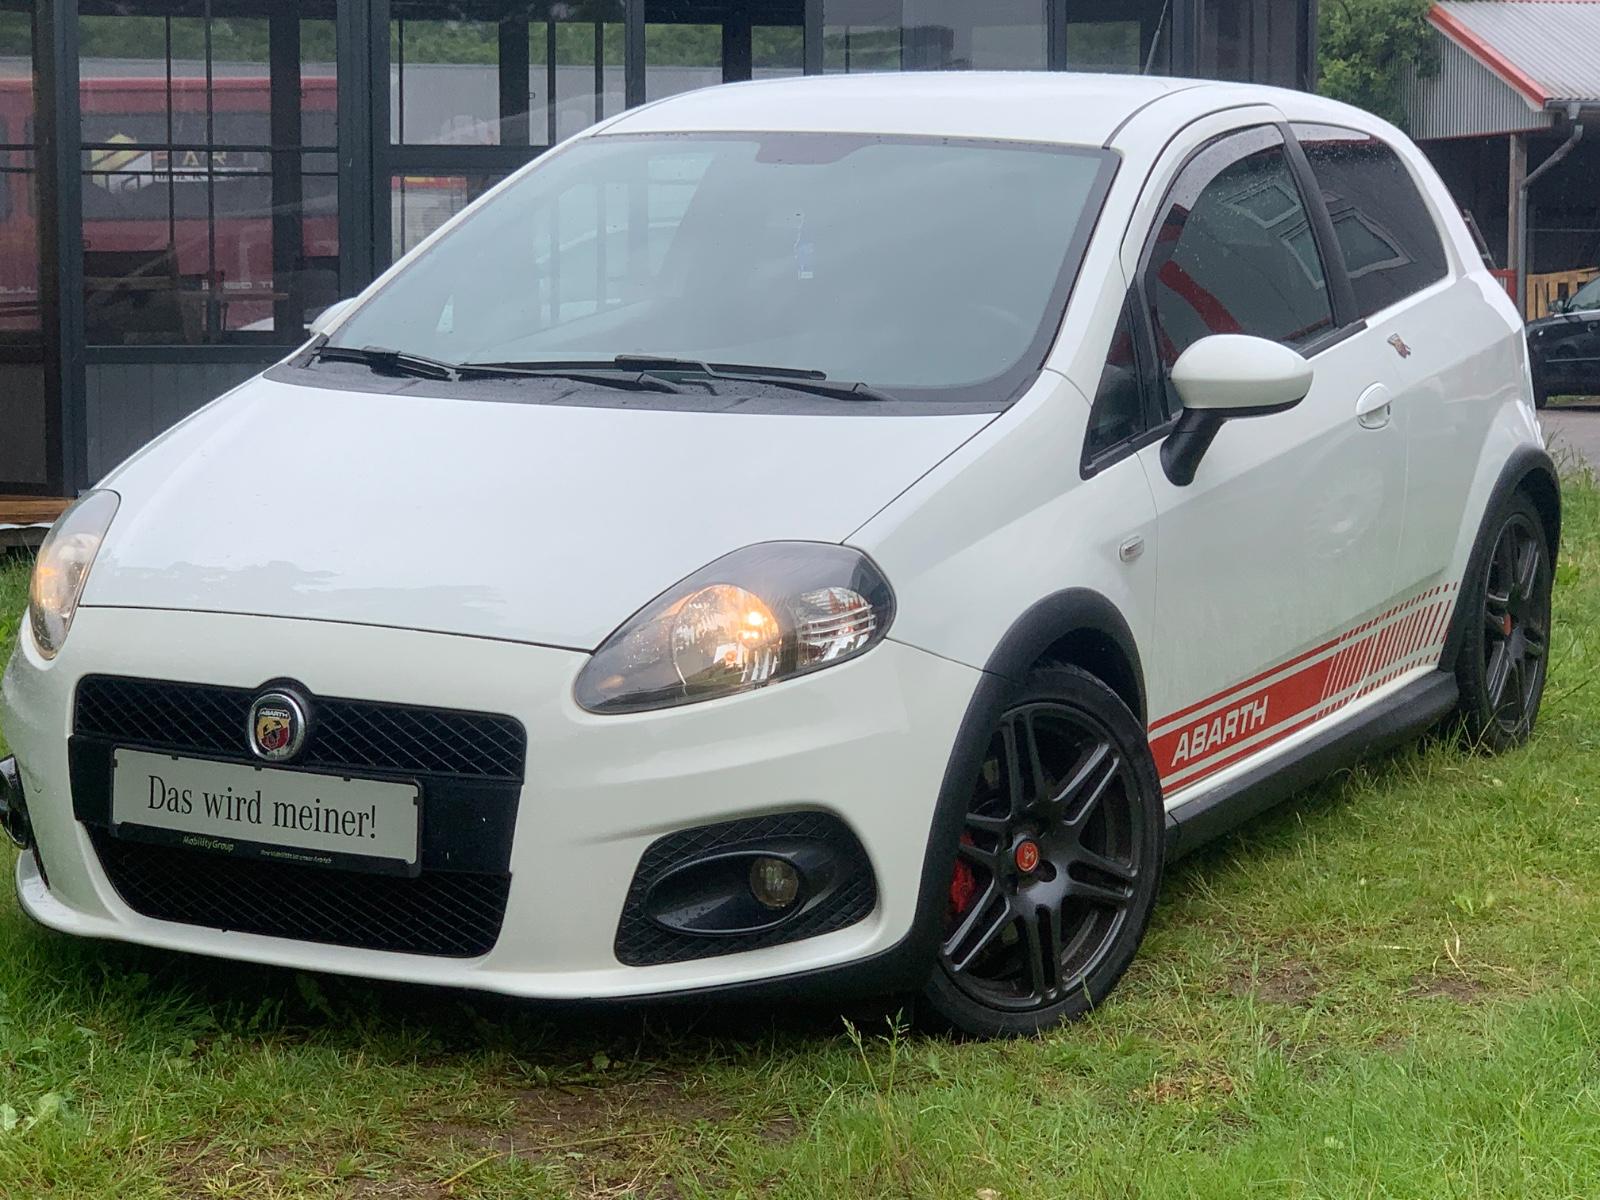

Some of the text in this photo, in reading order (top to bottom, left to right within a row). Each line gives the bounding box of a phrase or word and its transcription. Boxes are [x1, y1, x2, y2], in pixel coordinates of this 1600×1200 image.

[1170, 695, 1269, 768] ABARTH
[148, 775, 376, 839] Das wird meiner!
